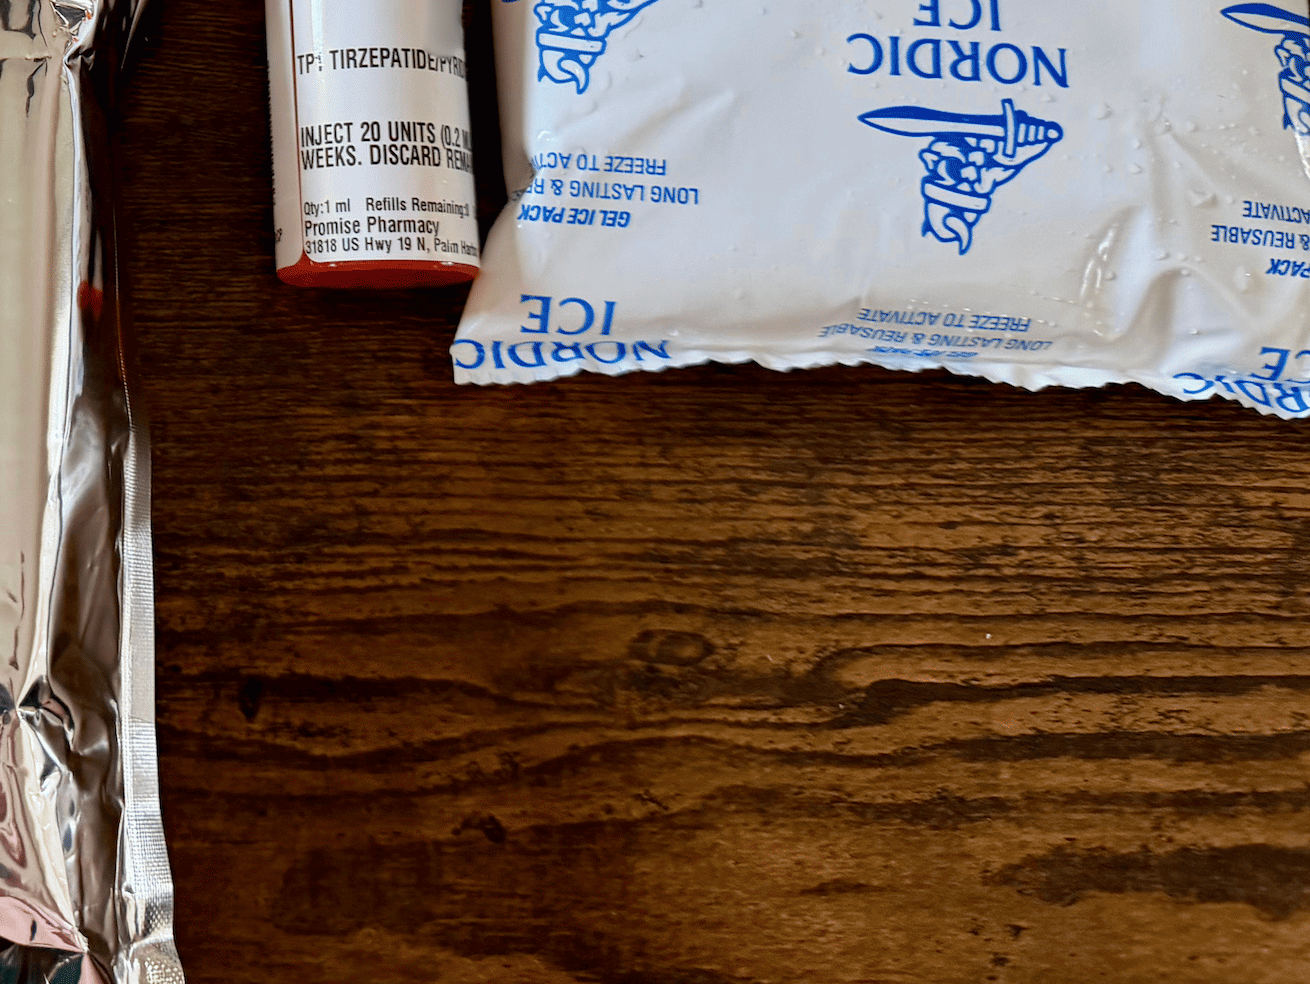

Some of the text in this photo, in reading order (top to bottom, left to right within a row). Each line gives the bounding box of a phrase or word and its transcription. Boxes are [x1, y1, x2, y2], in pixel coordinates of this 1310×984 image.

[846, 33, 1069, 88] NORDIC
[301, 122, 353, 147] INJECT
[360, 121, 380, 142] 20
[388, 121, 435, 143] UNITS
[441, 124, 460, 149] (0.2
[301, 145, 362, 170] WEEKS.
[369, 144, 441, 167] DISCARD
[576, 154, 600, 171] TO
[604, 156, 666, 176] FREEZE
[550, 178, 563, 196] &
[569, 180, 644, 201] LASTING
[650, 185, 699, 204] LONG
[304, 200, 330, 218] Qty:1
[336, 198, 350, 213] ml
[366, 197, 407, 212] Refills
[517, 203, 631, 228] GEL ICE PACK
[1242, 200, 1310, 224] ACTIVATE
[304, 218, 360, 237] Promise
[368, 216, 439, 237] Pharmacy
[1210, 224, 1295, 249] REUSABLE
[305, 239, 337, 255] 31818
[342, 238, 359, 252] US
[365, 237, 392, 253] Hwy
[397, 237, 412, 251] 19
[417, 236, 430, 253] N,
[434, 237, 459, 254] Palm
[520, 294, 617, 335] ICE
[856, 308, 1031, 332] FREEZE TO ACTIVATE
[817, 323, 1052, 351] LONG LASTING & REUSABLE
[452, 339, 671, 370] NORDIC
[1172, 372, 1310, 413] RDIC
